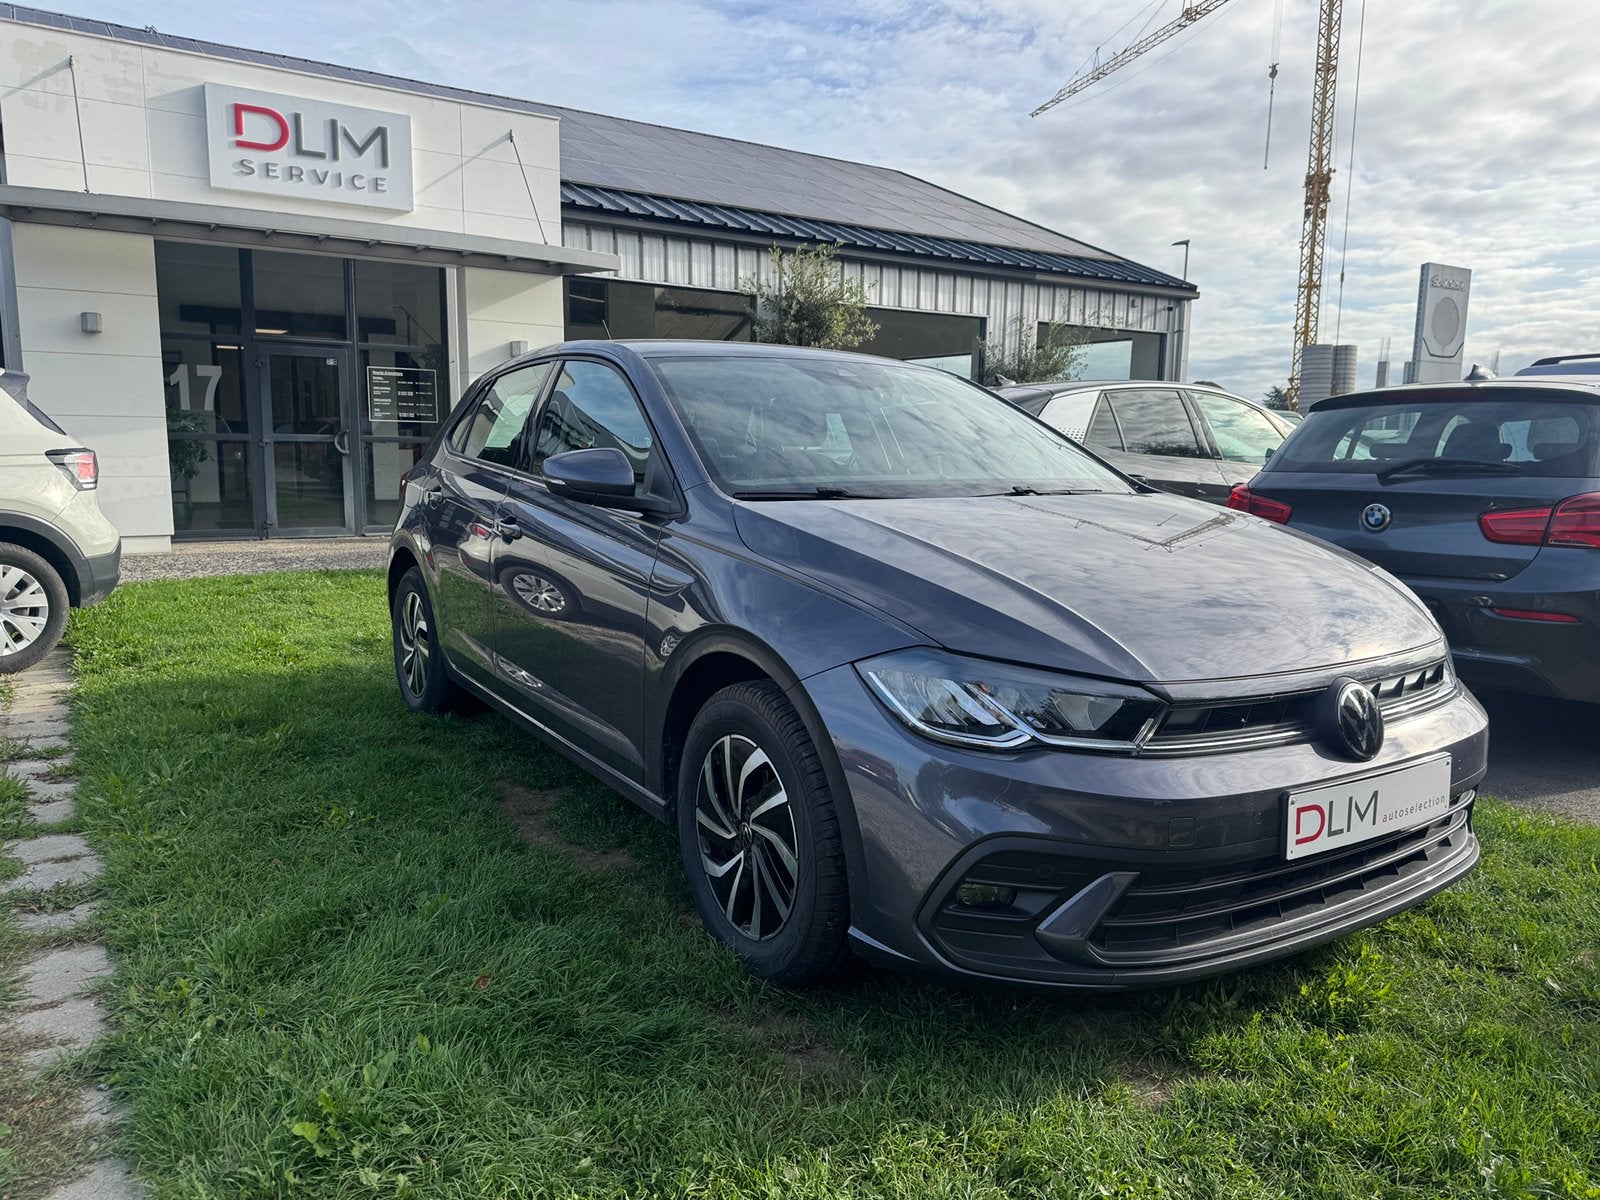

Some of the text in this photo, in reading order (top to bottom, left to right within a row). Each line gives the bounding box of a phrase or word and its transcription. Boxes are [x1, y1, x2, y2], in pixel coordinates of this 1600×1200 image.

[234, 102, 389, 168] DLM
[239, 158, 388, 193] SERVICE
[169, 364, 223, 411] 17
[1295, 789, 1446, 846] DLM autoselection
